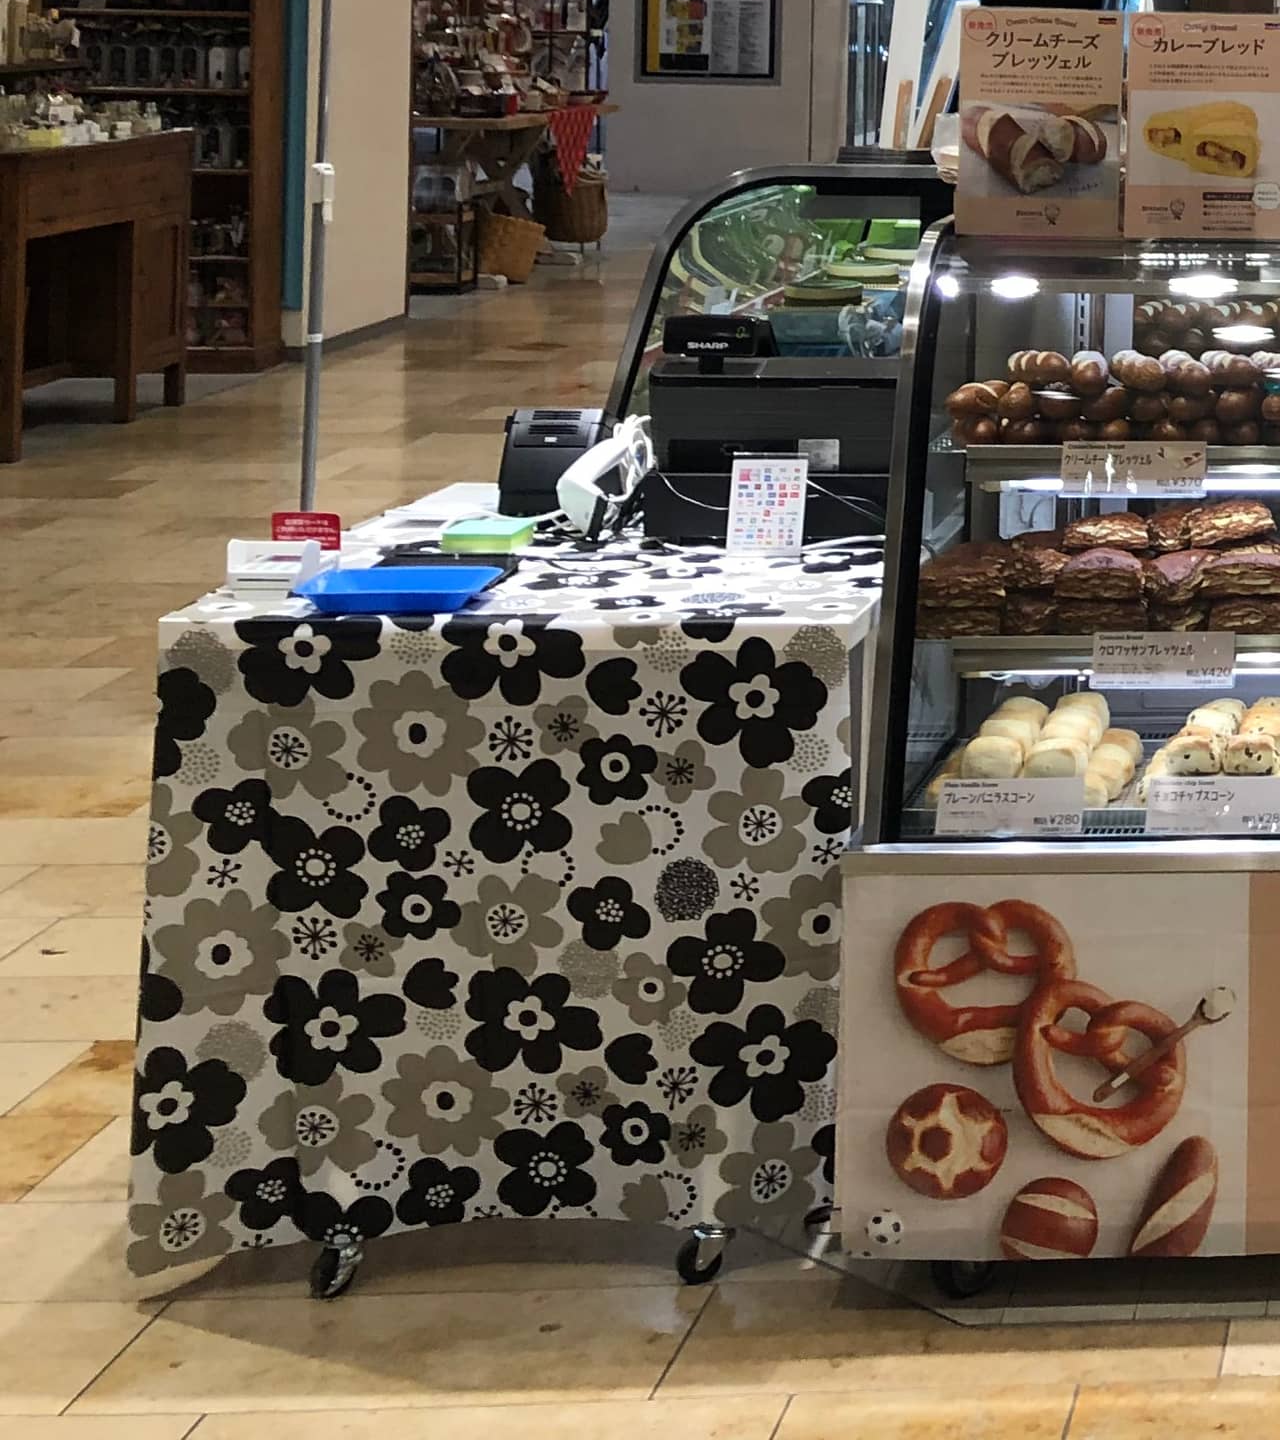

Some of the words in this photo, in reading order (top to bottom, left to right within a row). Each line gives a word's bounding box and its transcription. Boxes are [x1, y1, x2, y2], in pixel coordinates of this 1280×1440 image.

[985, 31, 1101, 50] クリームチーズ
[1152, 38, 1266, 56] カレーブレッド
[992, 51, 1092, 71] ブレッツェル
[687, 341, 729, 350] SHARP
[1049, 813, 1080, 825] ¥280
